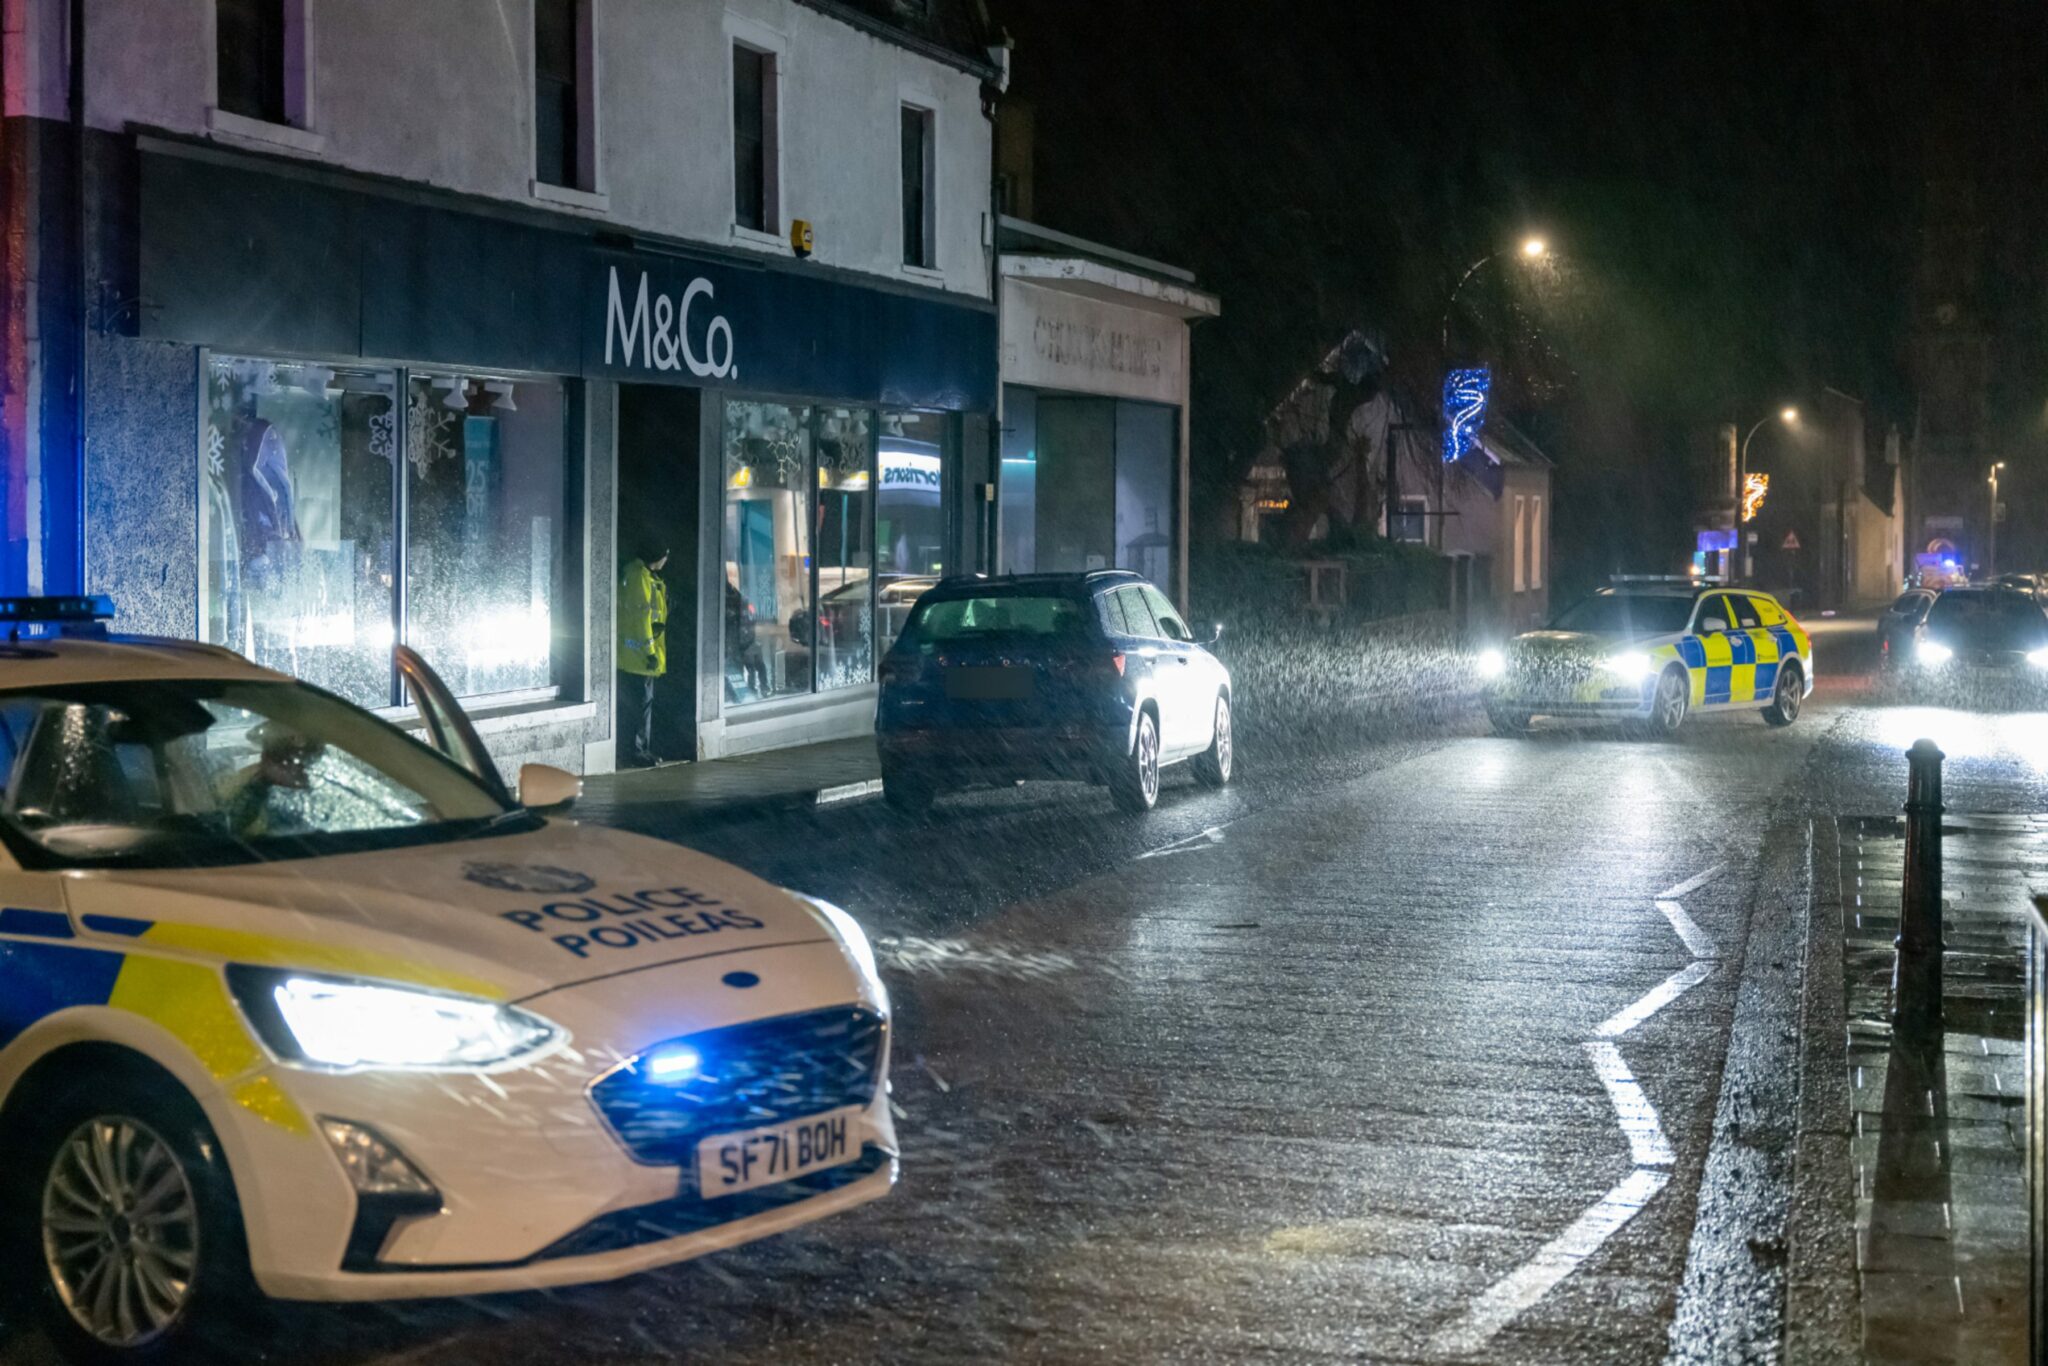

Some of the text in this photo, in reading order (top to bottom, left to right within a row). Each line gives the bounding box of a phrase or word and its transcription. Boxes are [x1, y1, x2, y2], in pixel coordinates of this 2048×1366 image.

[604, 265, 738, 380] M&Co.
[501, 887, 722, 932] POLICE
[551, 909, 765, 958] POILEAS
[719, 1116, 846, 1185] SF71 BOH
